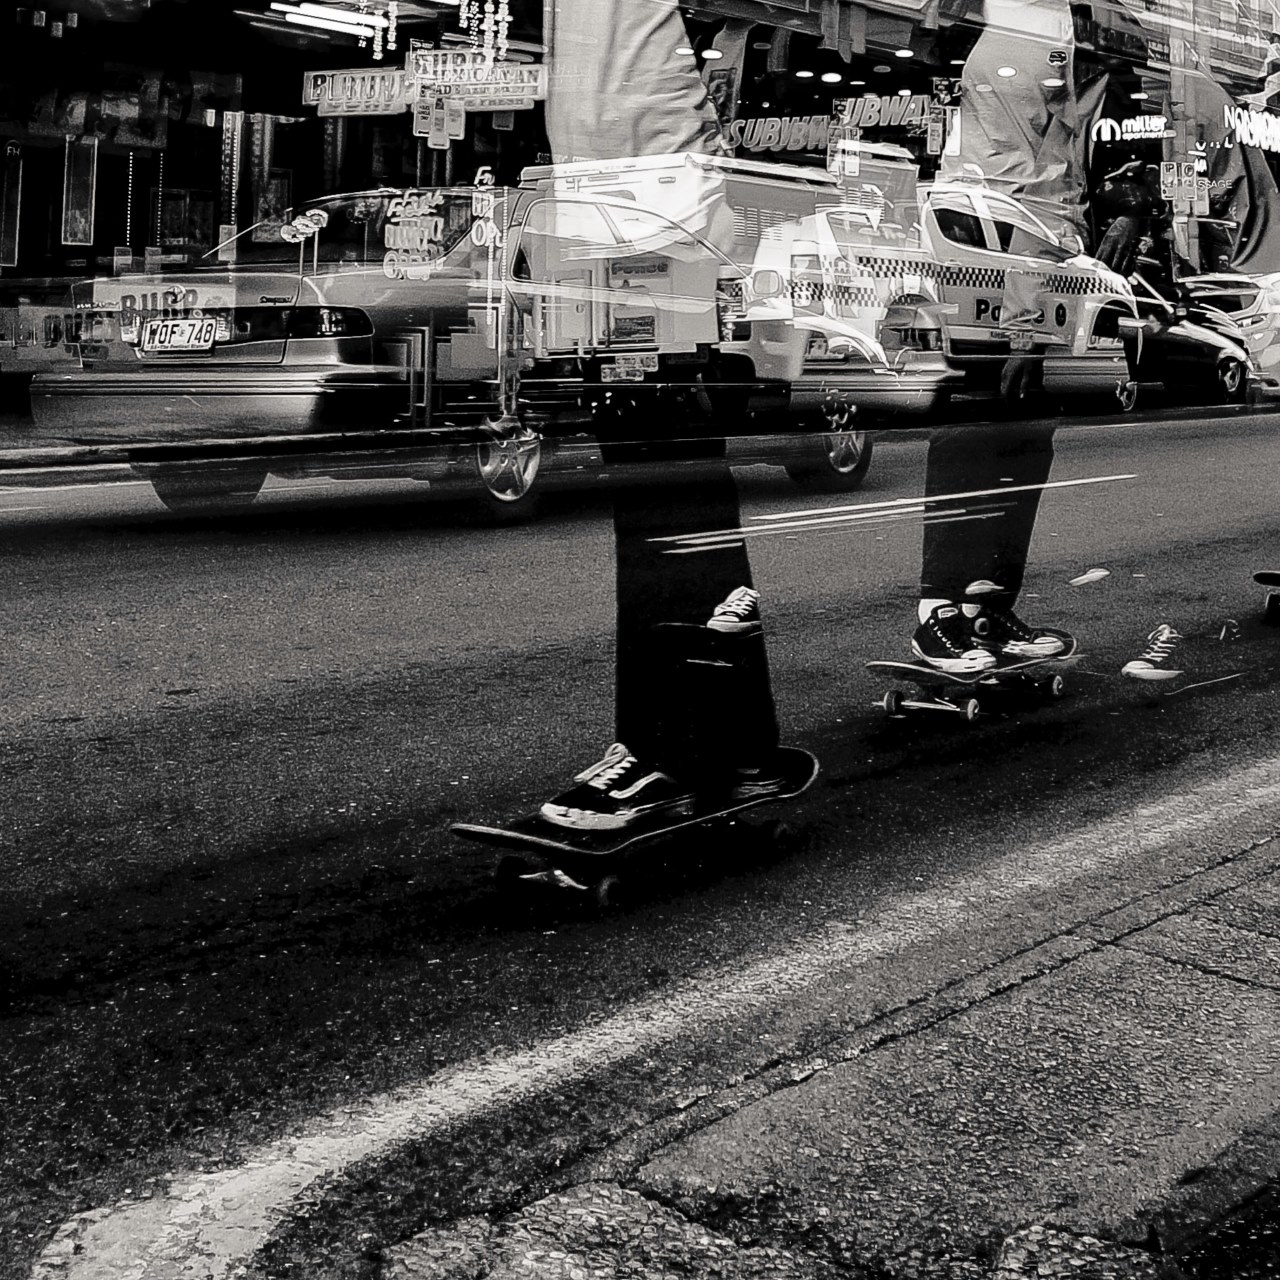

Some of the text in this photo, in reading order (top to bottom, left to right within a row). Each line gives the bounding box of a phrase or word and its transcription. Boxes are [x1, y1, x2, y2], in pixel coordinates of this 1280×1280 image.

[842, 94, 933, 127] UBWAY
[1122, 115, 1167, 133] miller
[7, 147, 20, 157] FH
[147, 323, 214, 345] WOF 748
